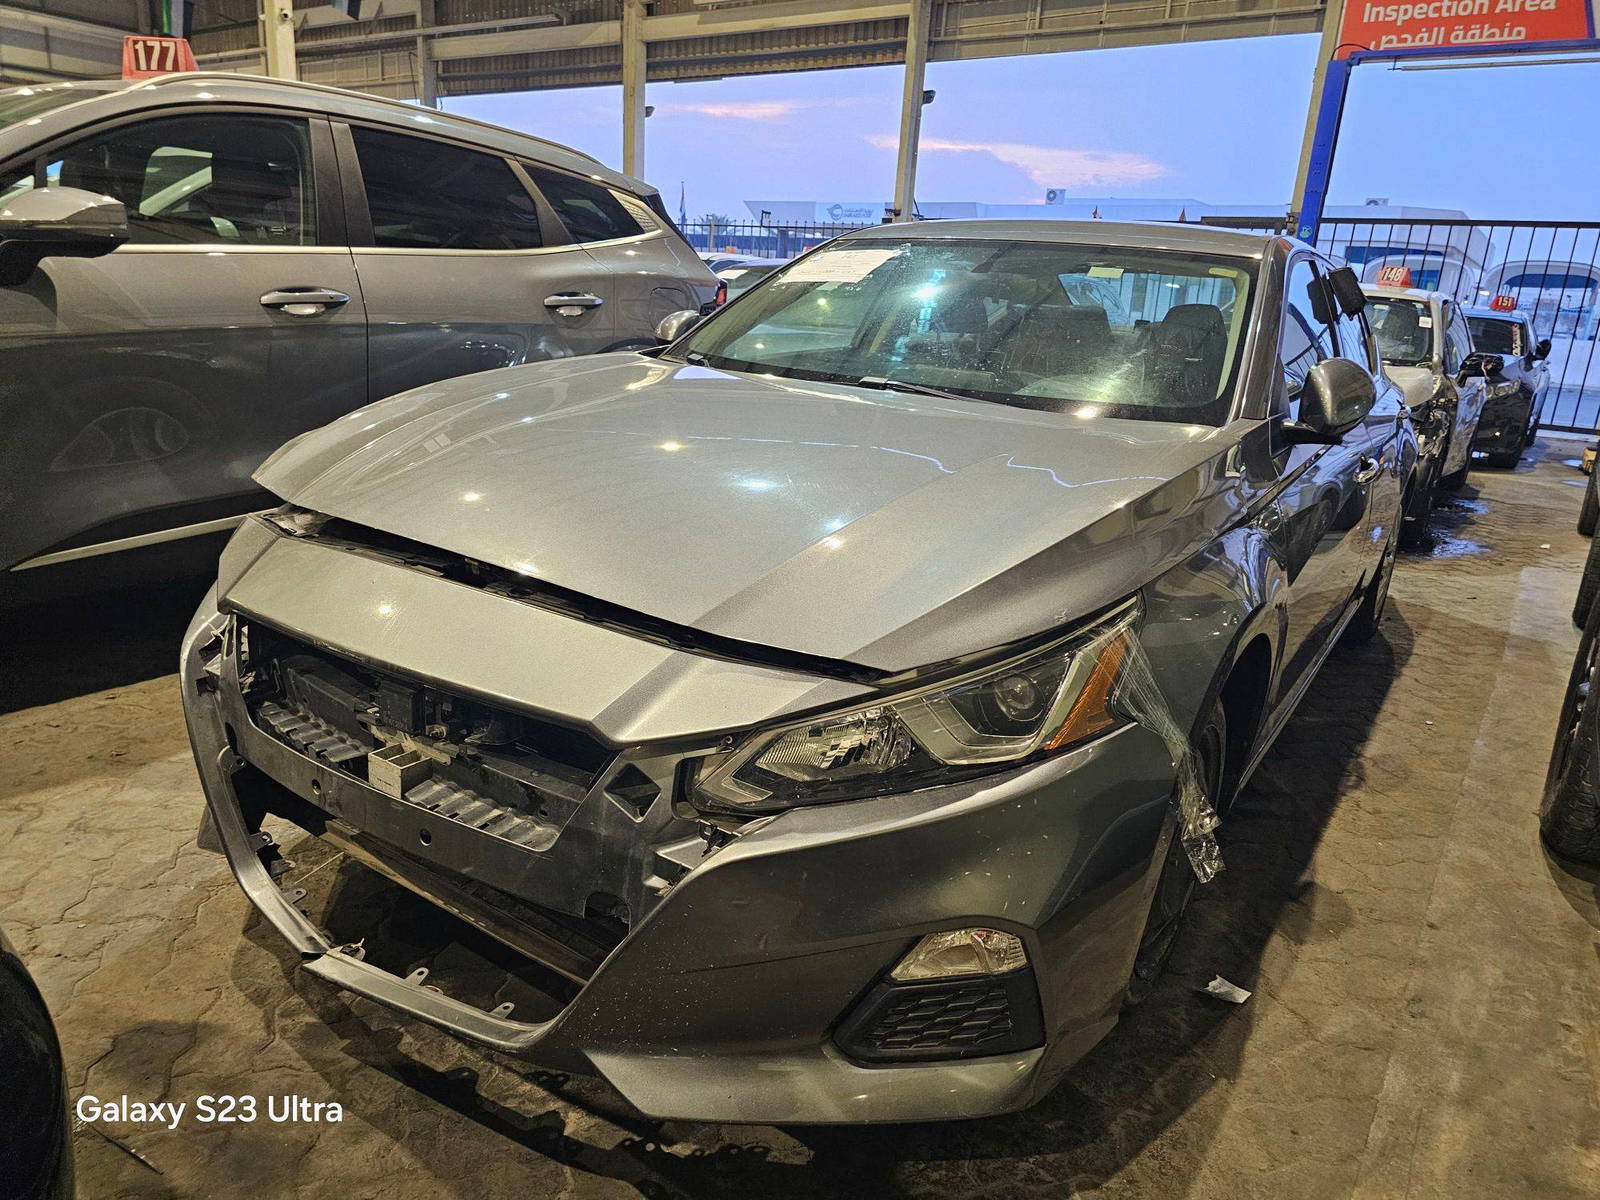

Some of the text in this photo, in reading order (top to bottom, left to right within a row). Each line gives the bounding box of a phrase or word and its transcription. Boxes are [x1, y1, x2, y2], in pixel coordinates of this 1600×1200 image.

[1362, 0, 1557, 26] Inspection Area
[1369, 22, 1527, 51] منطقة الفحص
[134, 40, 176, 71] 177
[1497, 296, 1513, 307] 151
